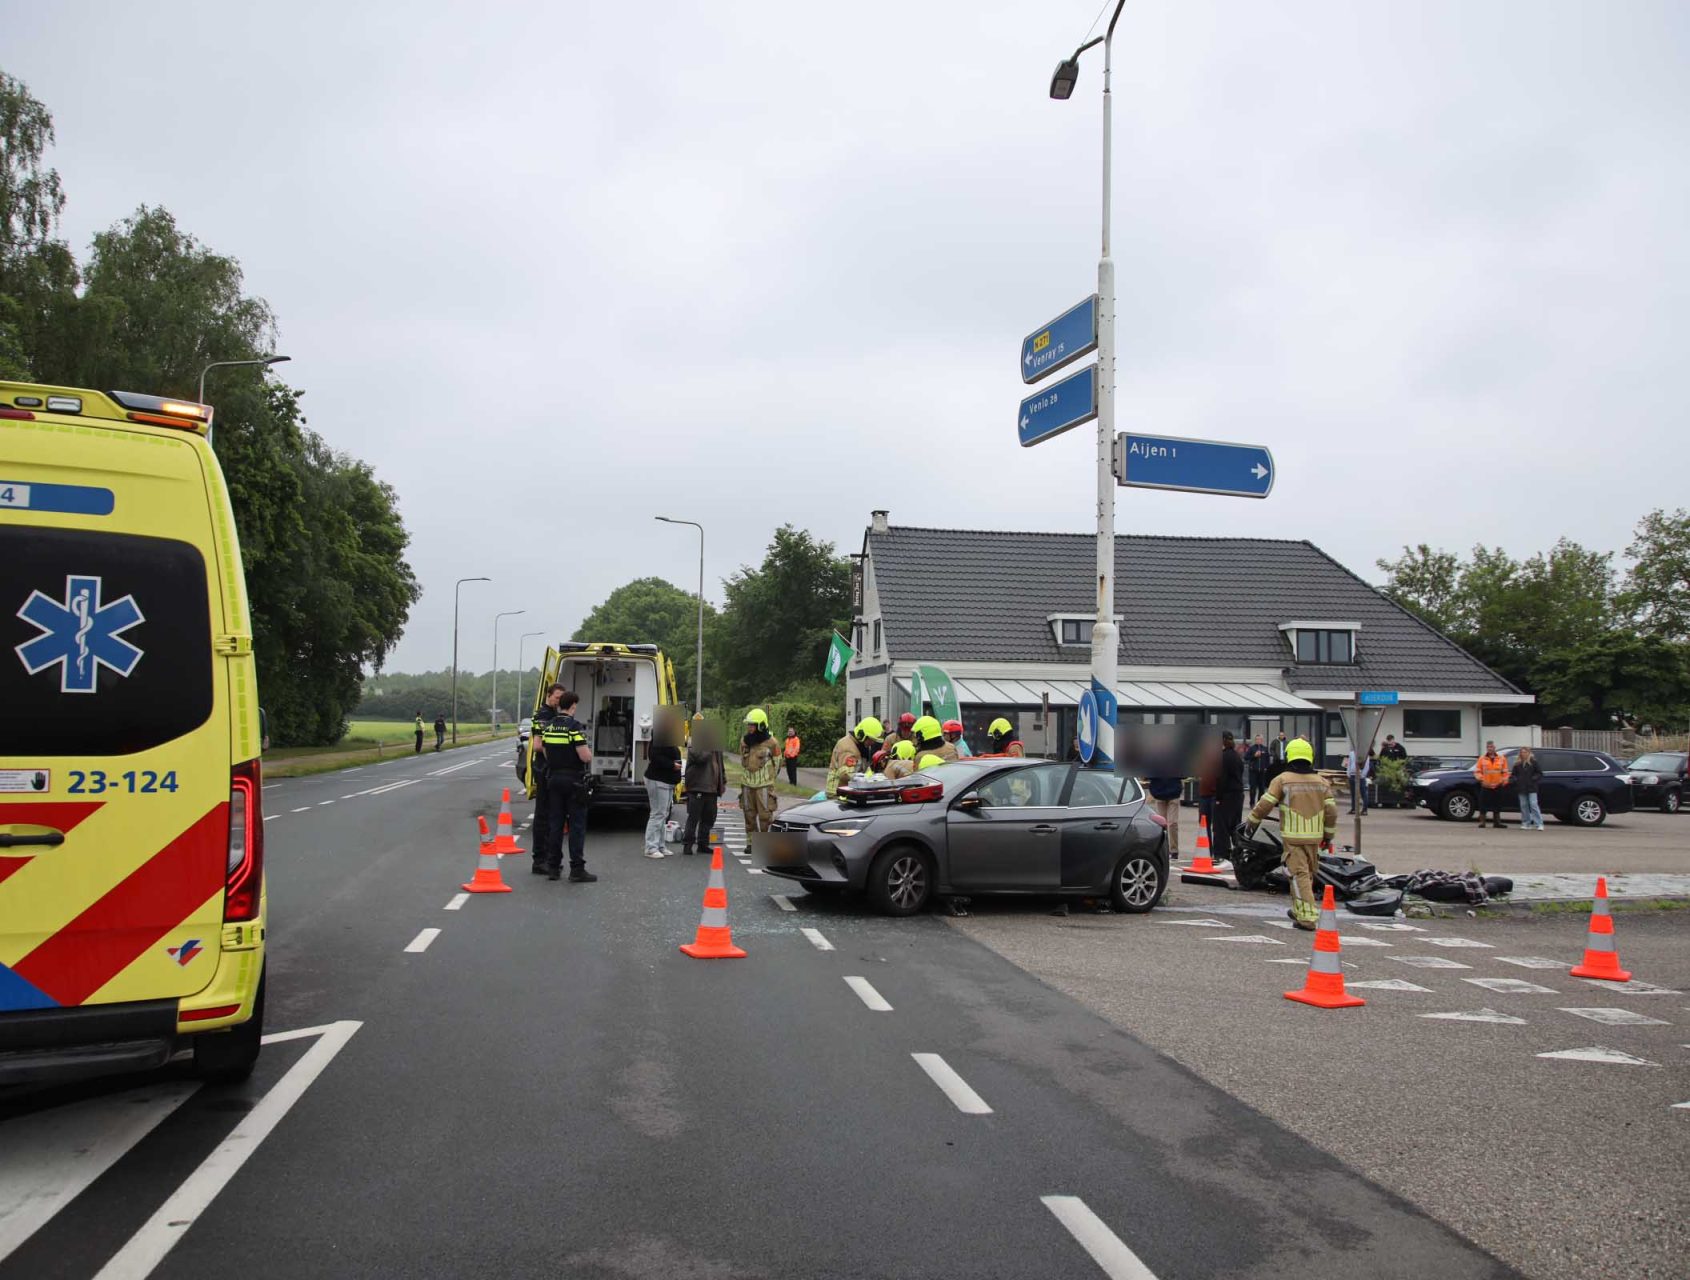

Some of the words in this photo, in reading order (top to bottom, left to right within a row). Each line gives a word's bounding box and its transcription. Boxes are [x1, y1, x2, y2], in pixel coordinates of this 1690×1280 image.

[1033, 348, 1057, 367] Venray
[1029, 397, 1049, 414] Venlo
[1130, 441, 1167, 459] Aijen
[1172, 447, 1177, 458] 1
[67, 770, 179, 794] 23-124
